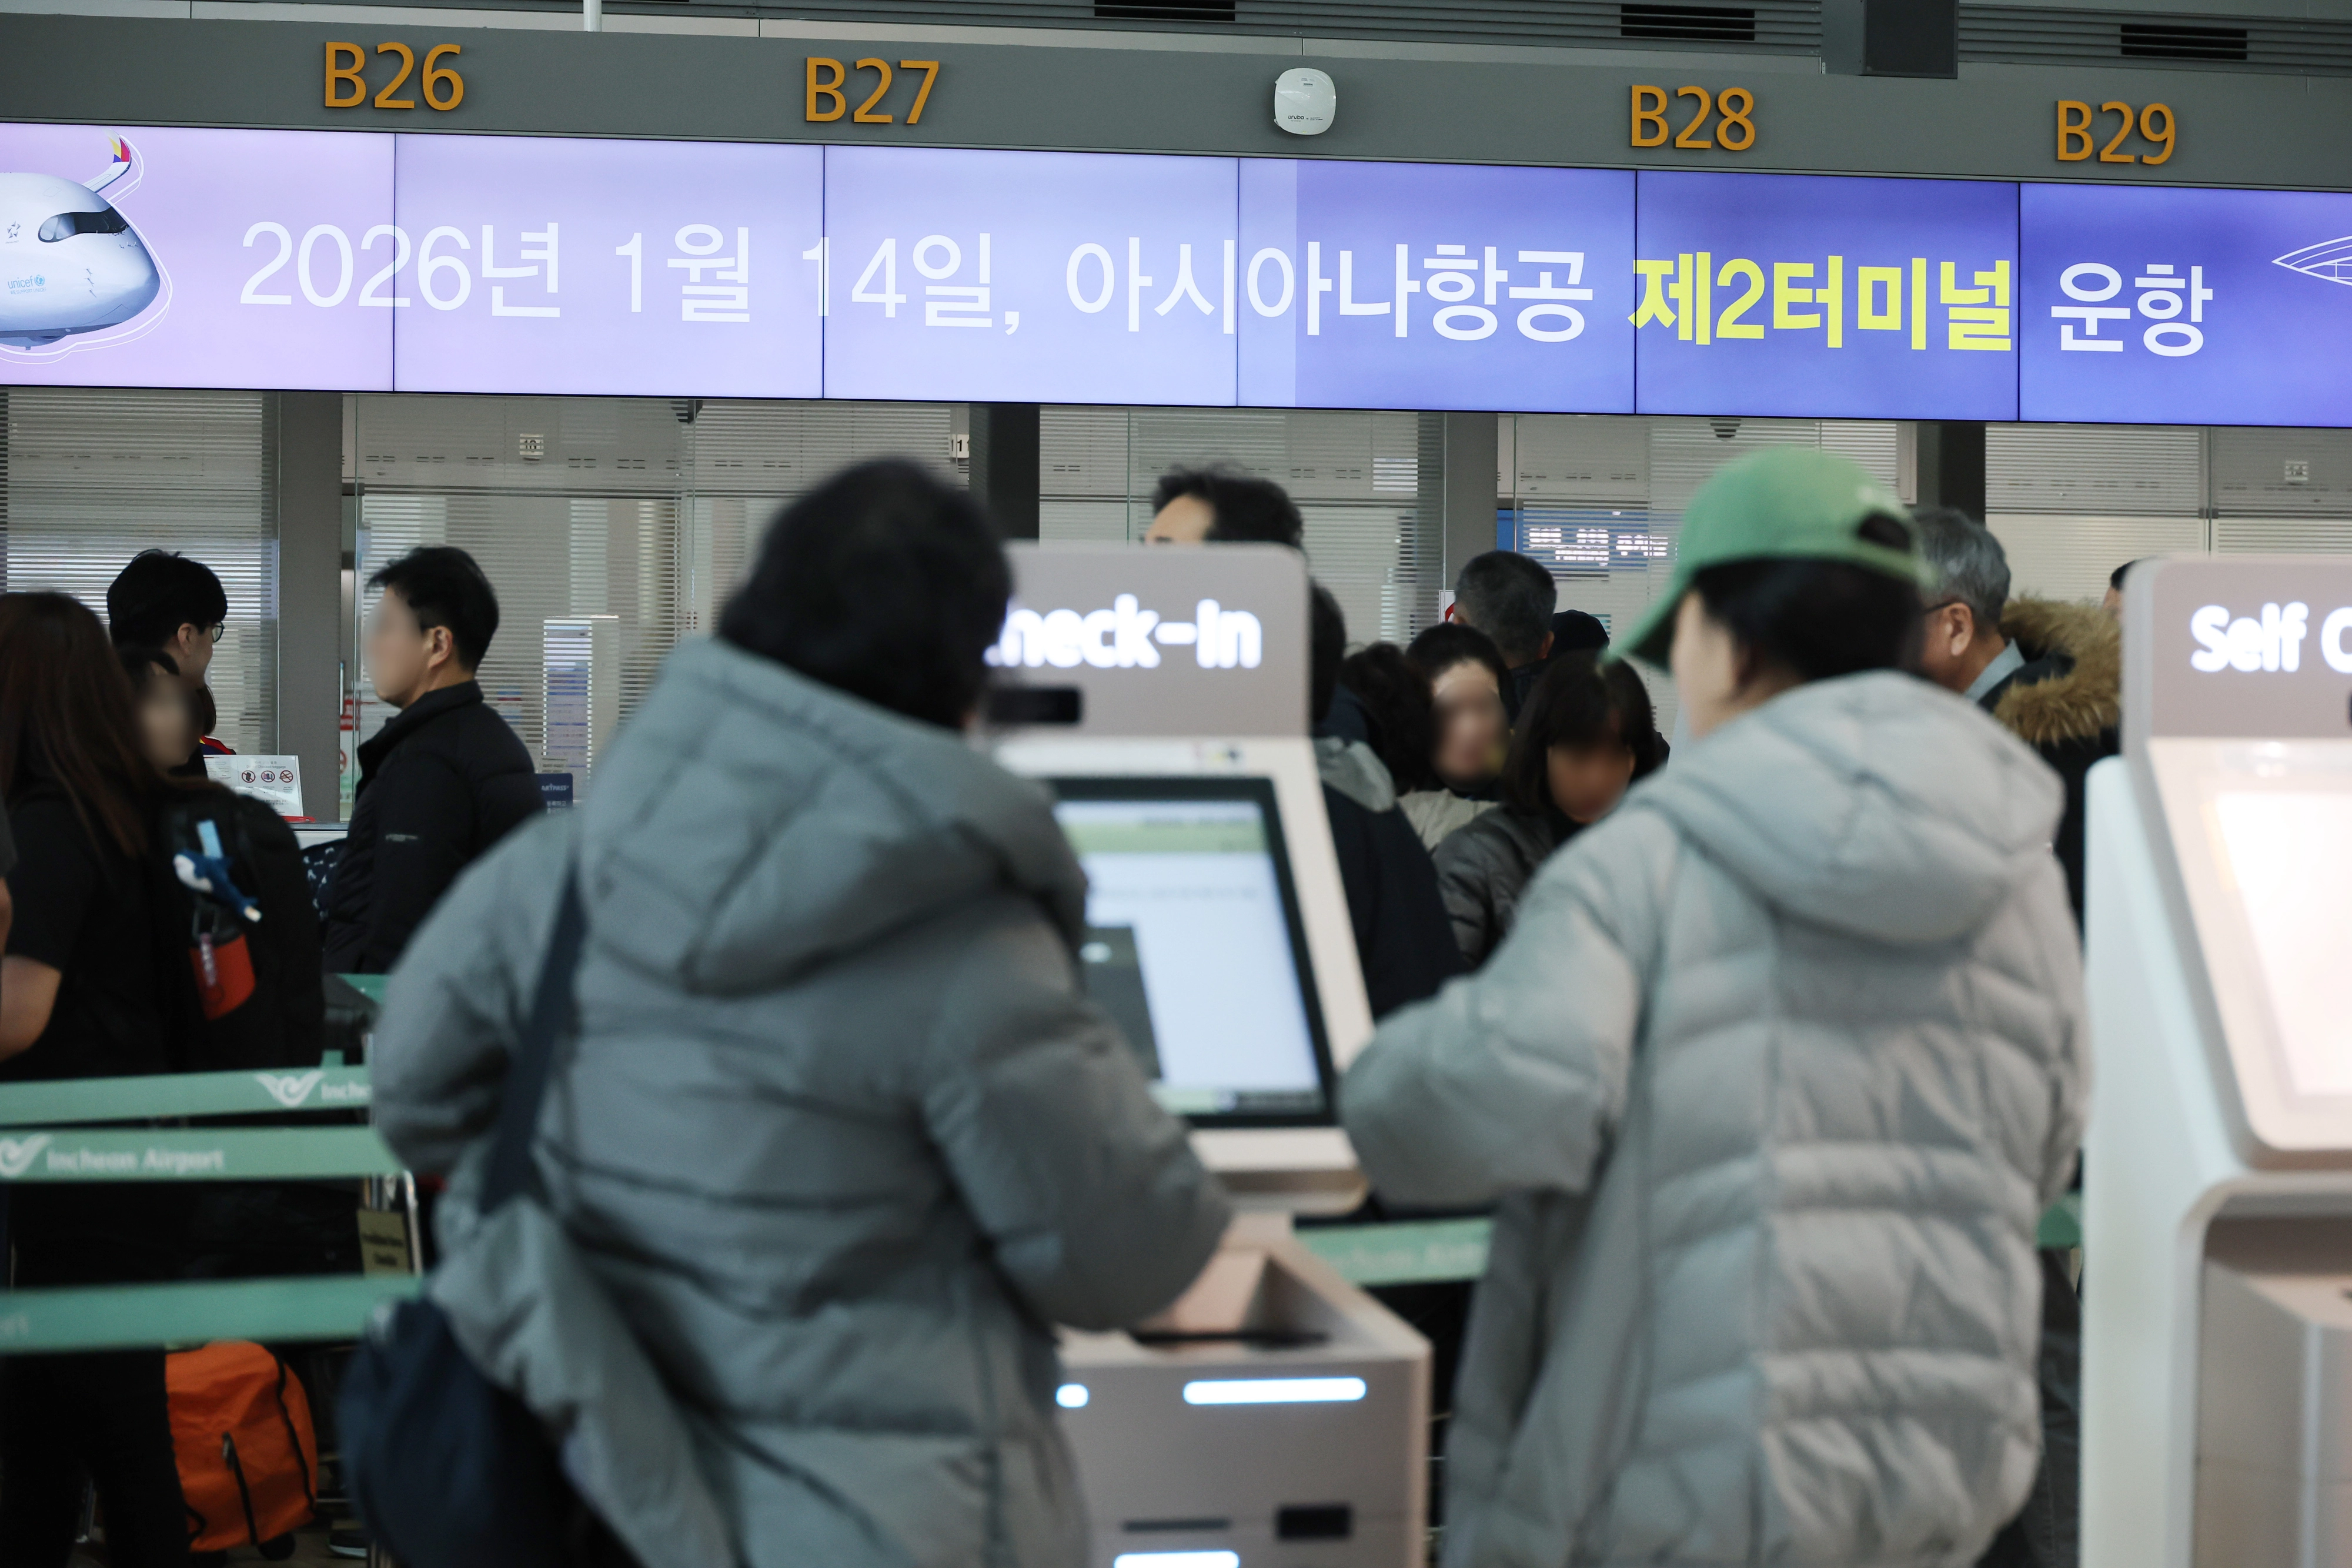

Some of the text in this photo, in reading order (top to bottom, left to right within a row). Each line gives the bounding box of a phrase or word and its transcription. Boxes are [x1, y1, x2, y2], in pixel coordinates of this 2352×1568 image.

[324, 41, 465, 111] B26
[805, 57, 940, 125] B27
[1629, 85, 1756, 151] B28
[2055, 100, 2176, 165] B29
[7, 275, 33, 289] unicef
[240, 220, 2213, 357] 2026년 1월 14일, 아시아나항공 제2터미널 운항
[983, 593, 1262, 670] heck-In
[2190, 601, 2310, 672] Self
[46, 1148, 225, 1175] Incheon Airport
